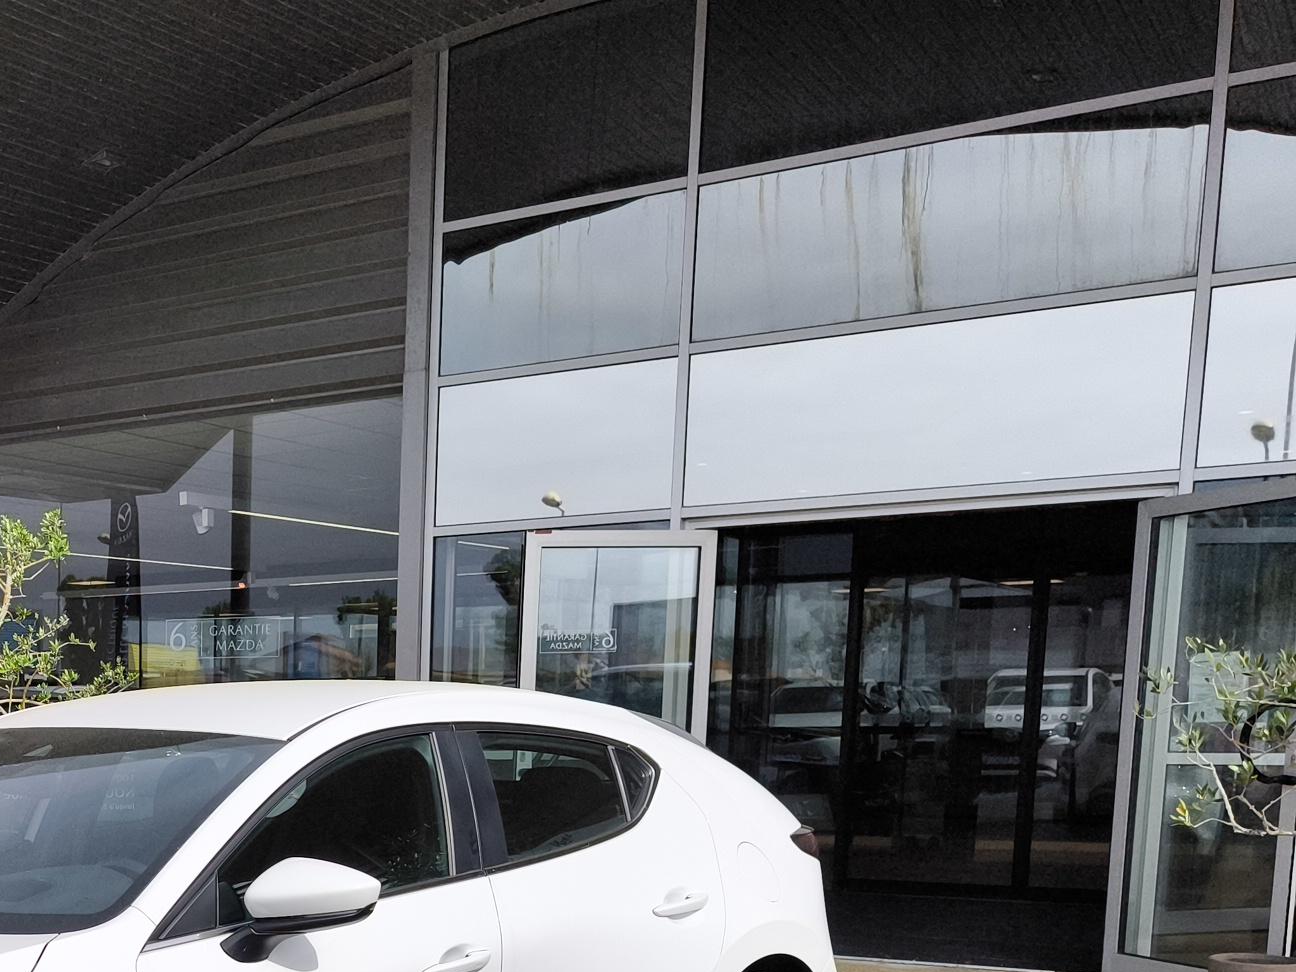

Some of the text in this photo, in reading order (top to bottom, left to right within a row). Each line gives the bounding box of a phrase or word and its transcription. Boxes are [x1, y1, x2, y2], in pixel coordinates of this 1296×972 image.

[169, 622, 187, 652] 6
[209, 623, 272, 637] GARANTIE
[215, 639, 265, 651] MAZDA
